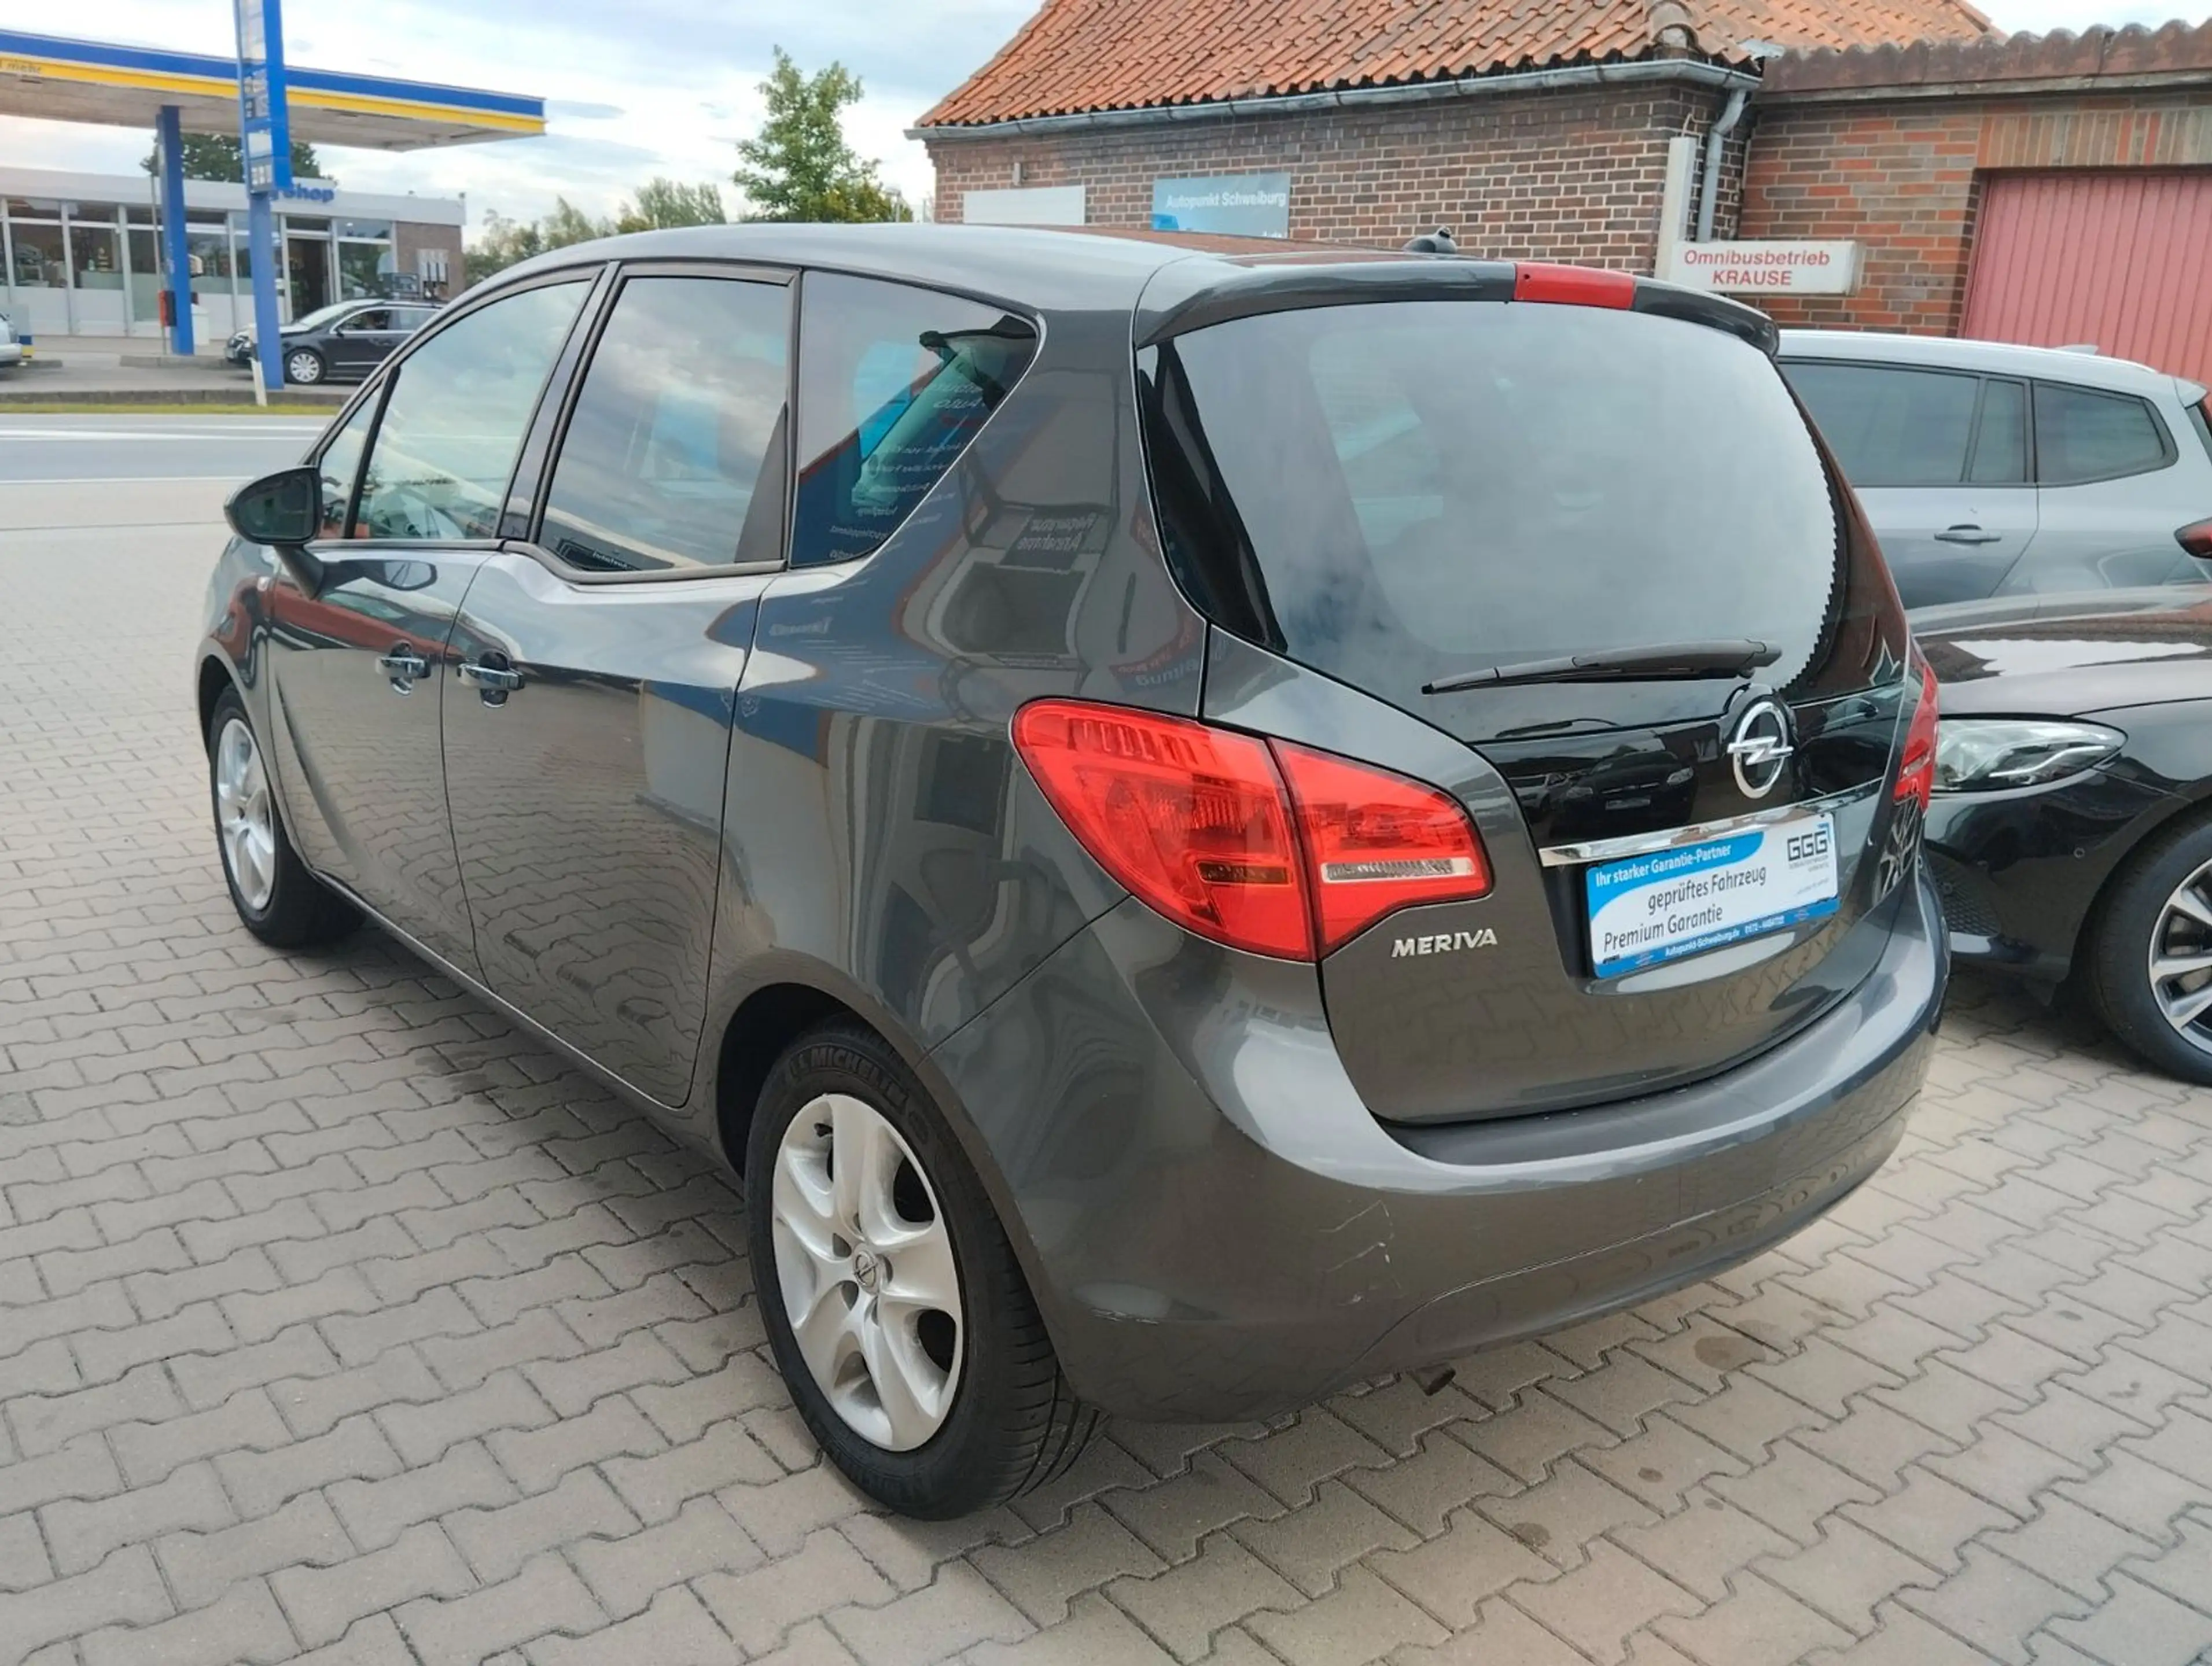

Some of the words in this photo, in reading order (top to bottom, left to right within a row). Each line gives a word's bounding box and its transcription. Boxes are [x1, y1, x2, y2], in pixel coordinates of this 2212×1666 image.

[1684, 250, 1830, 266] Omnibusbetrieb
[1713, 270, 1793, 286] KRAUSE
[1787, 830, 1827, 861] GGG
[1595, 871, 1611, 887] Ihr
[1613, 863, 1649, 883] starker
[1651, 845, 1732, 873] Garantie-Partner
[1648, 879, 1709, 916] geprüftes
[1711, 866, 1767, 894] Fahrzeug
[1391, 928, 1497, 958] MERIVA
[1603, 923, 1664, 953] Premium
[1667, 903, 1724, 935] Garantie
